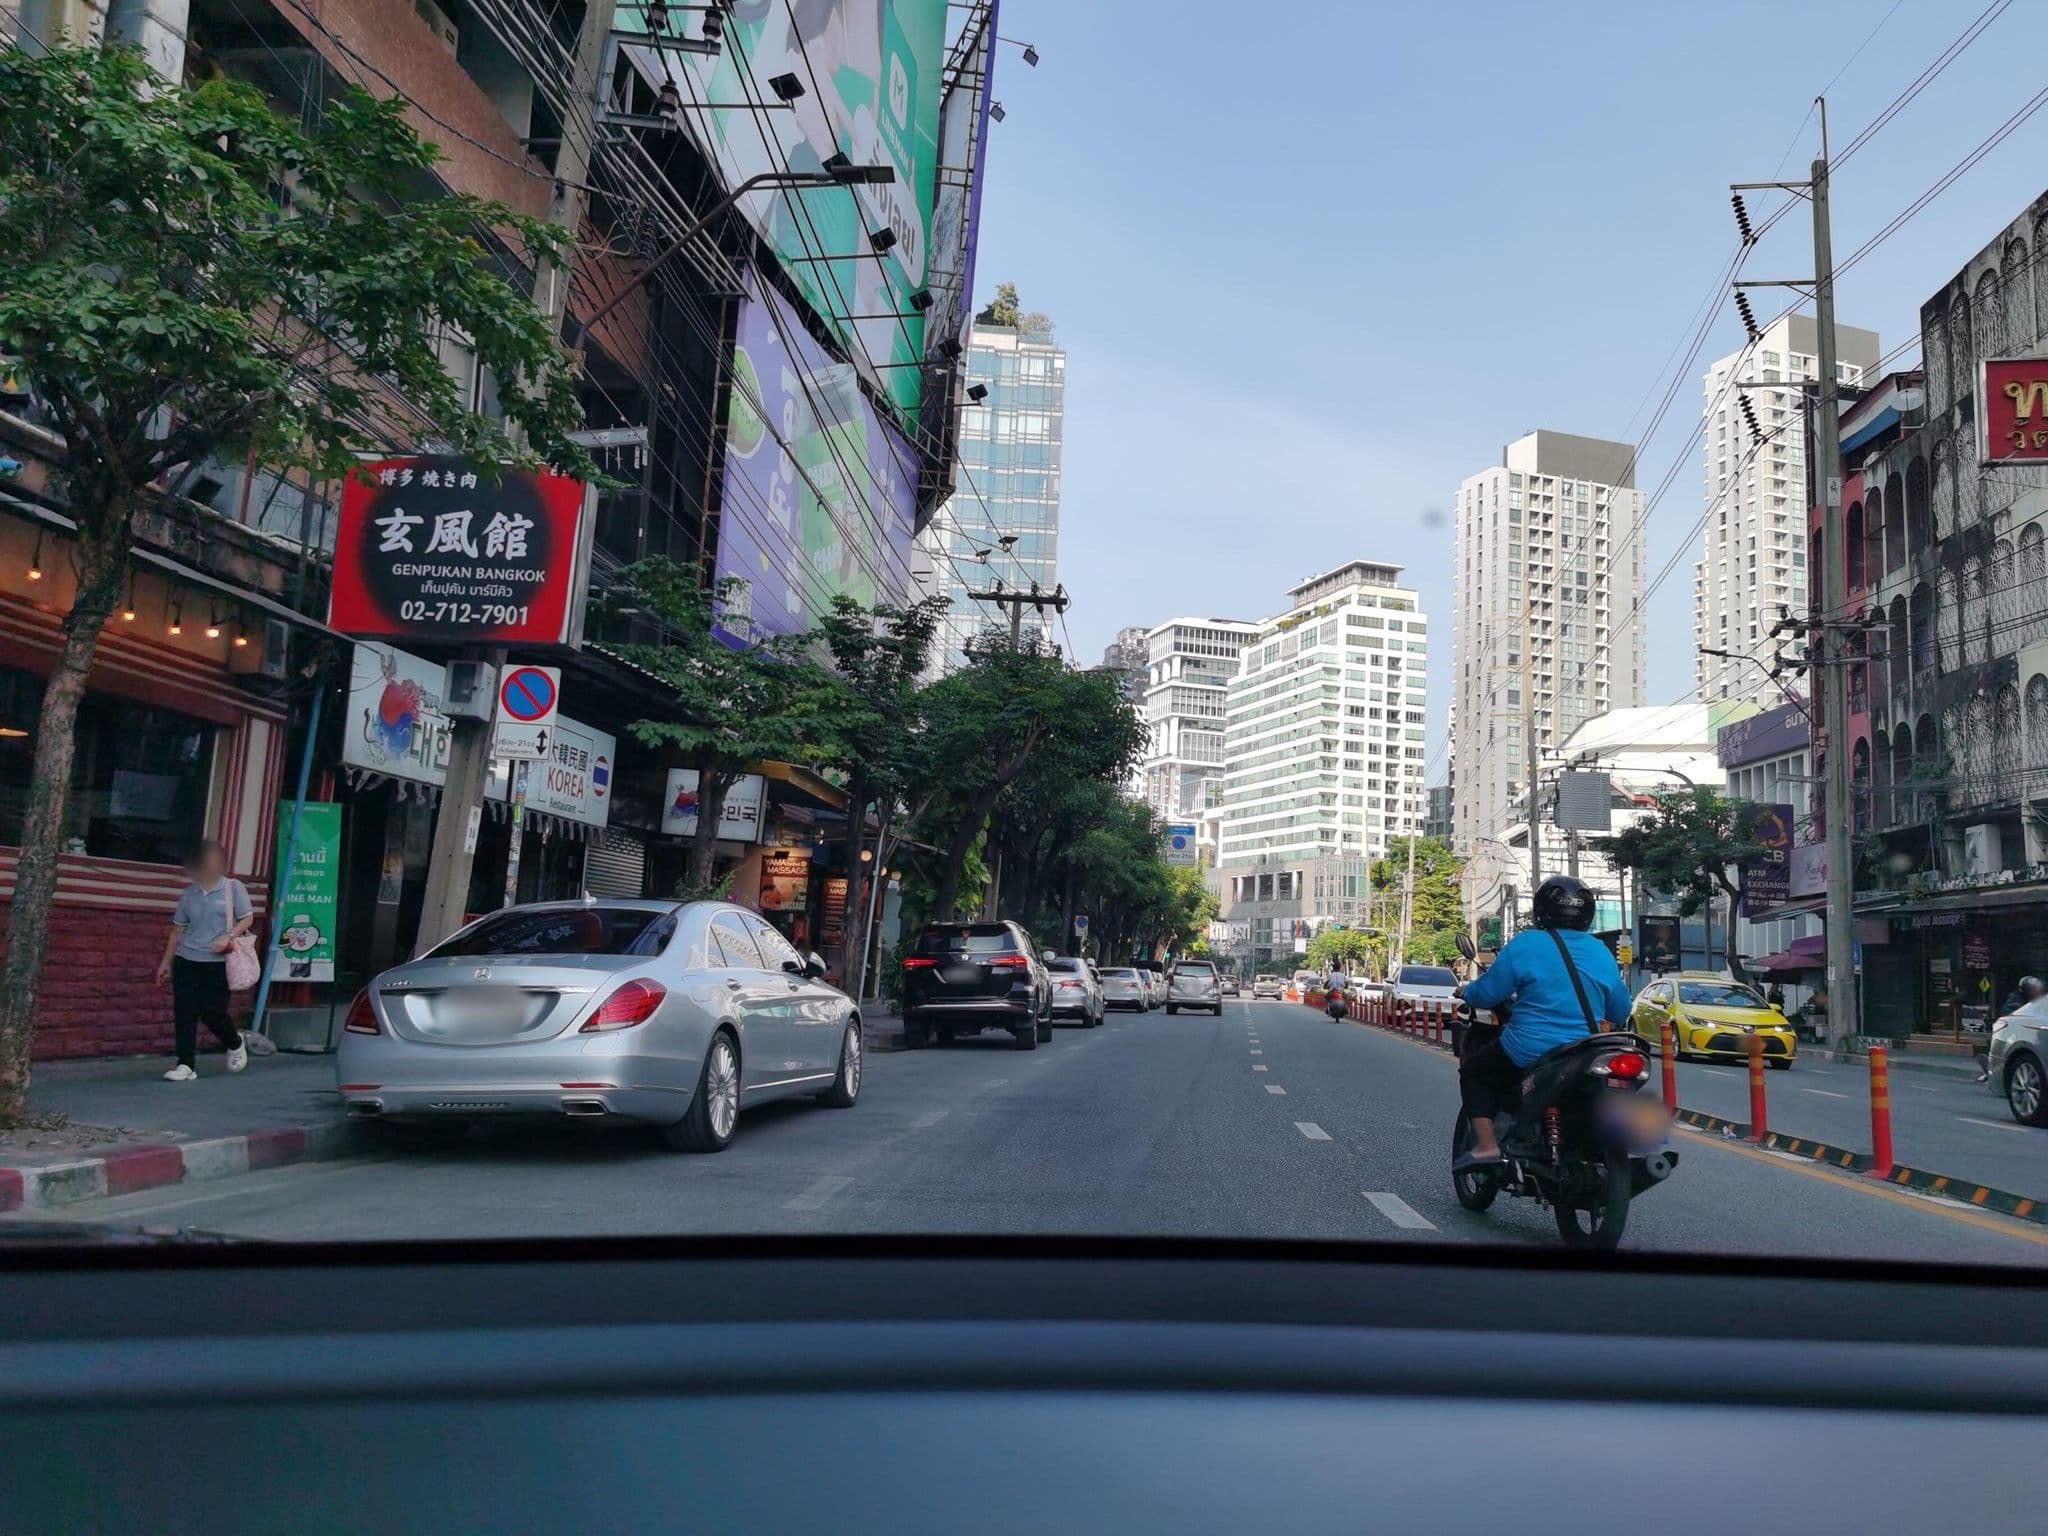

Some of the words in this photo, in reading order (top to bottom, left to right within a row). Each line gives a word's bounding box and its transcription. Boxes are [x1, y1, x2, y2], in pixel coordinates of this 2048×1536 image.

[379, 467, 415, 488] 博多
[421, 470, 478, 491] 焼き肉
[374, 507, 536, 562] 玄風館
[391, 562, 473, 579] GENPUKAN
[474, 567, 546, 583] BANGKOK
[399, 600, 530, 627] 02-712-7901
[547, 765, 585, 800] KOREA
[1762, 849, 1785, 863] CB
[767, 866, 809, 875] MASSAGE
[1747, 869, 1767, 878] ATM
[287, 894, 306, 904] INE
[307, 894, 332, 905] MAN
